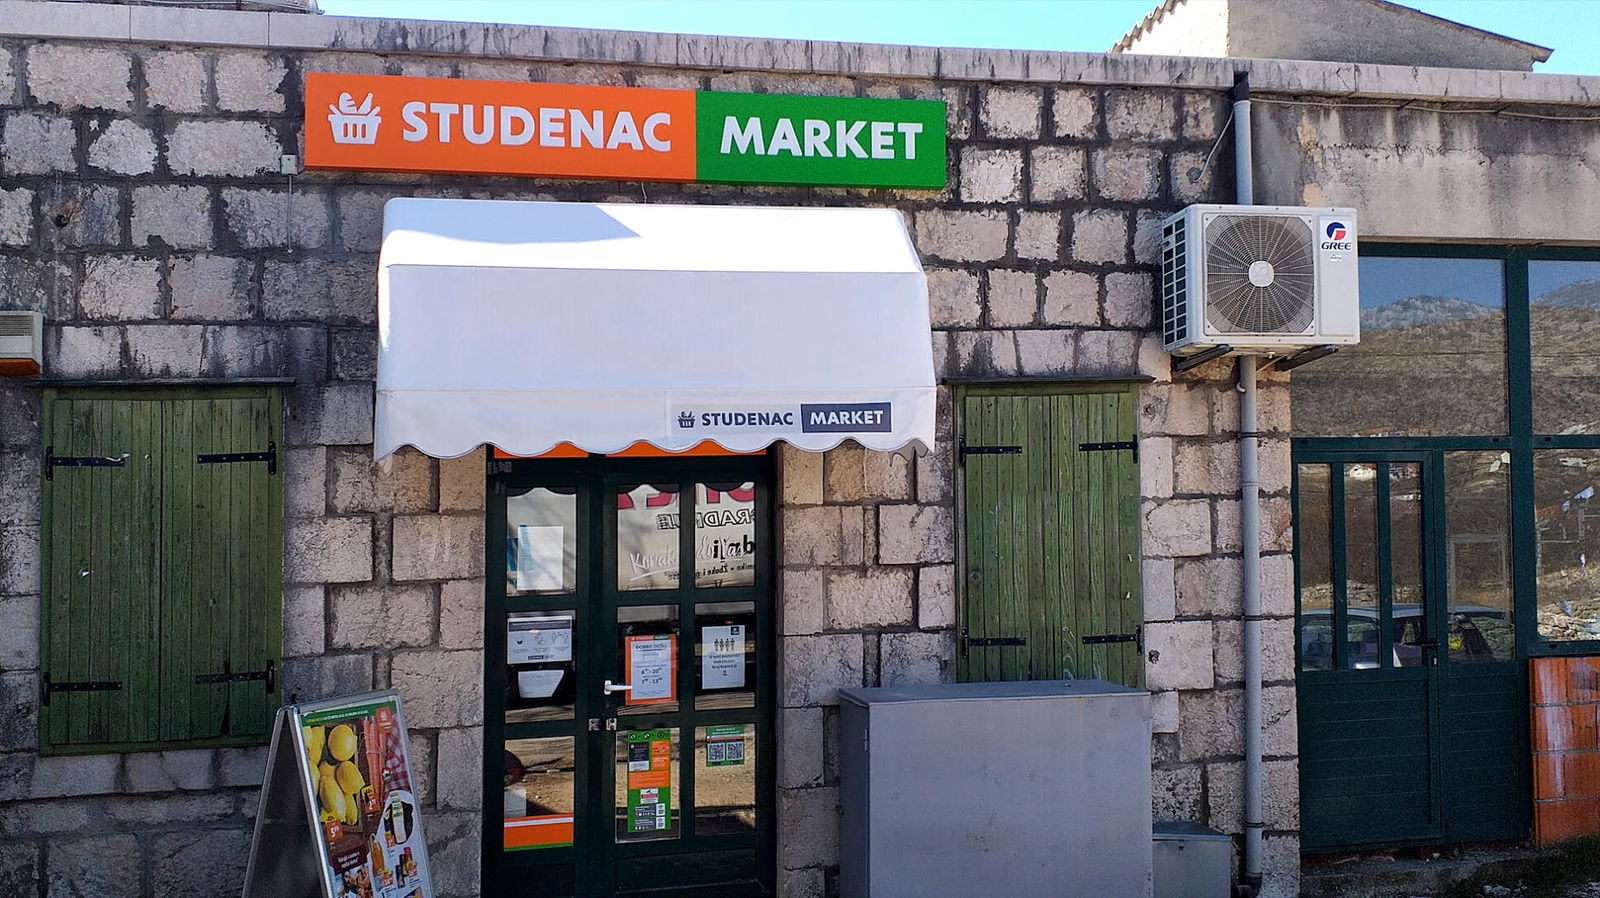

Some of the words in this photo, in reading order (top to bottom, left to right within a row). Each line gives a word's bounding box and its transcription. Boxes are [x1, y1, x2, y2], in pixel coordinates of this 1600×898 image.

[402, 101, 671, 153] STUDENAC
[720, 115, 923, 160] MARKET
[1321, 241, 1352, 251] GREE
[702, 411, 794, 426] STUDENAC
[809, 410, 884, 425] MARKET
